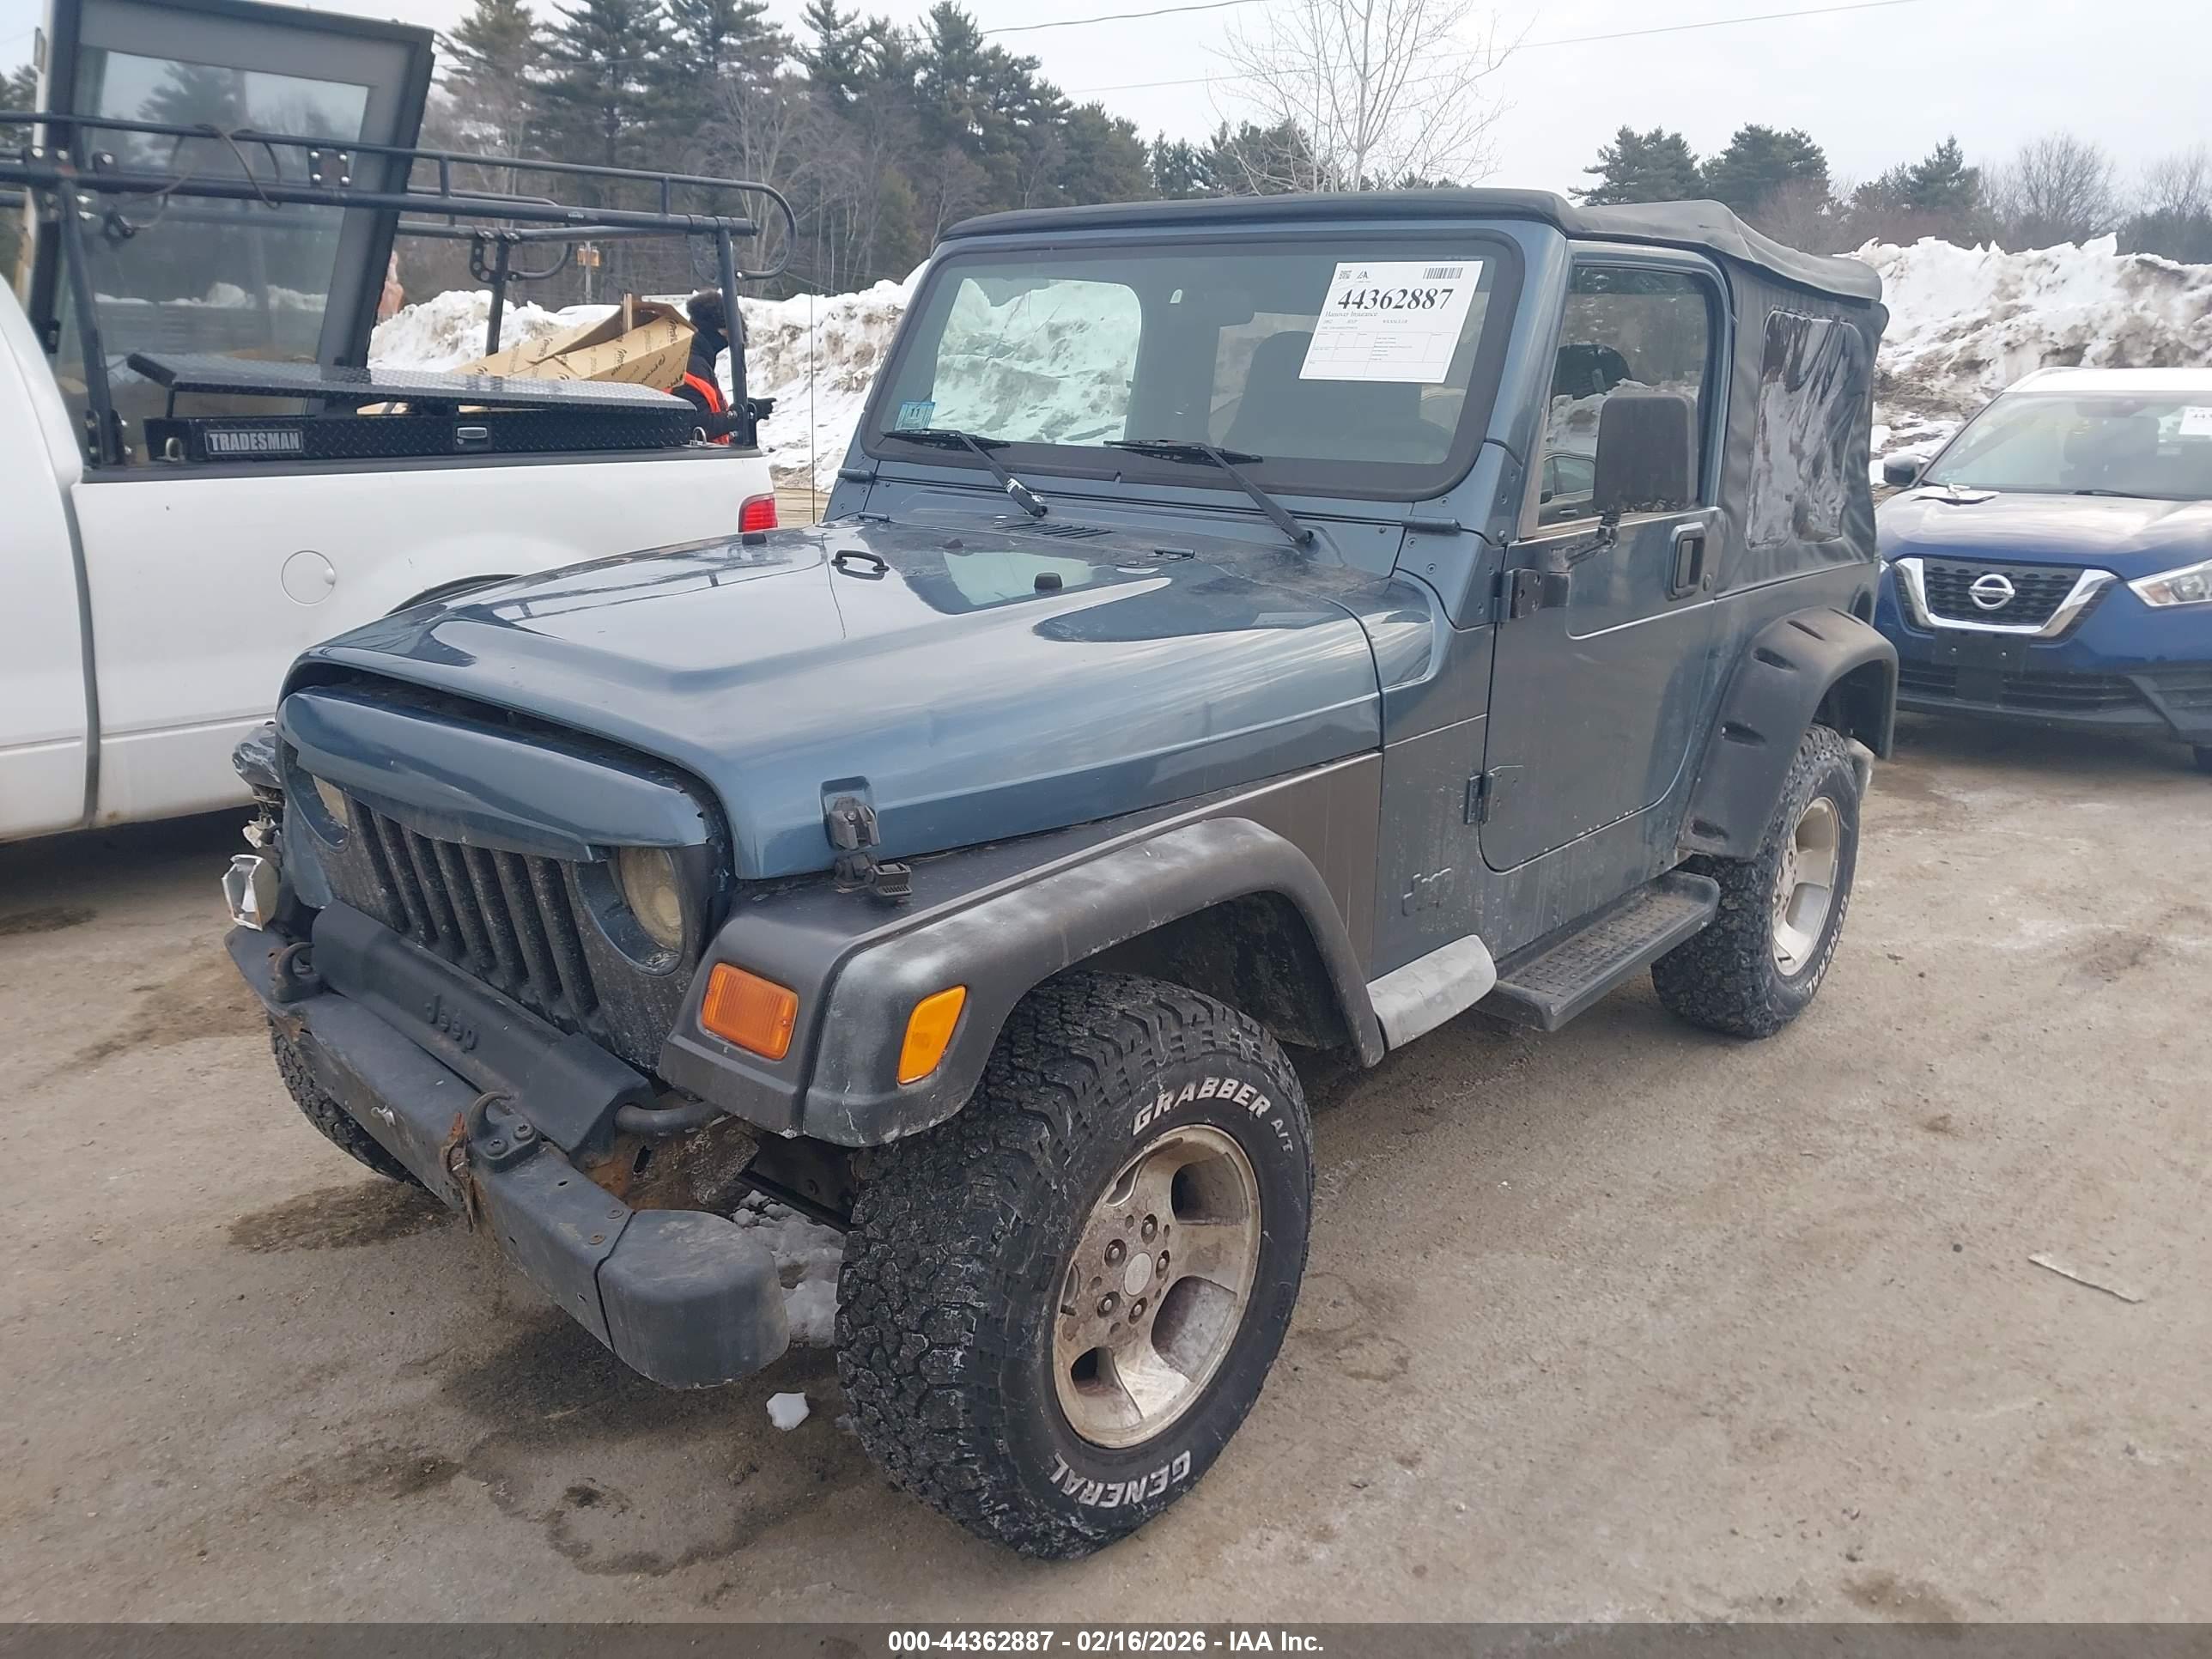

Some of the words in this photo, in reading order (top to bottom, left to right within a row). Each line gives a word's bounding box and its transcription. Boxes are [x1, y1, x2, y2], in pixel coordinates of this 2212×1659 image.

[1338, 288, 1455, 310] 44362887
[210, 432, 300, 452] TRADESMAN
[1806, 894, 1848, 995] GENERAL
[424, 992, 479, 1054] Jeep
[1133, 1077, 1271, 1137] GRABBER
[1271, 1118, 1293, 1153] A/T
[1049, 1450, 1191, 1509] GENERAL
